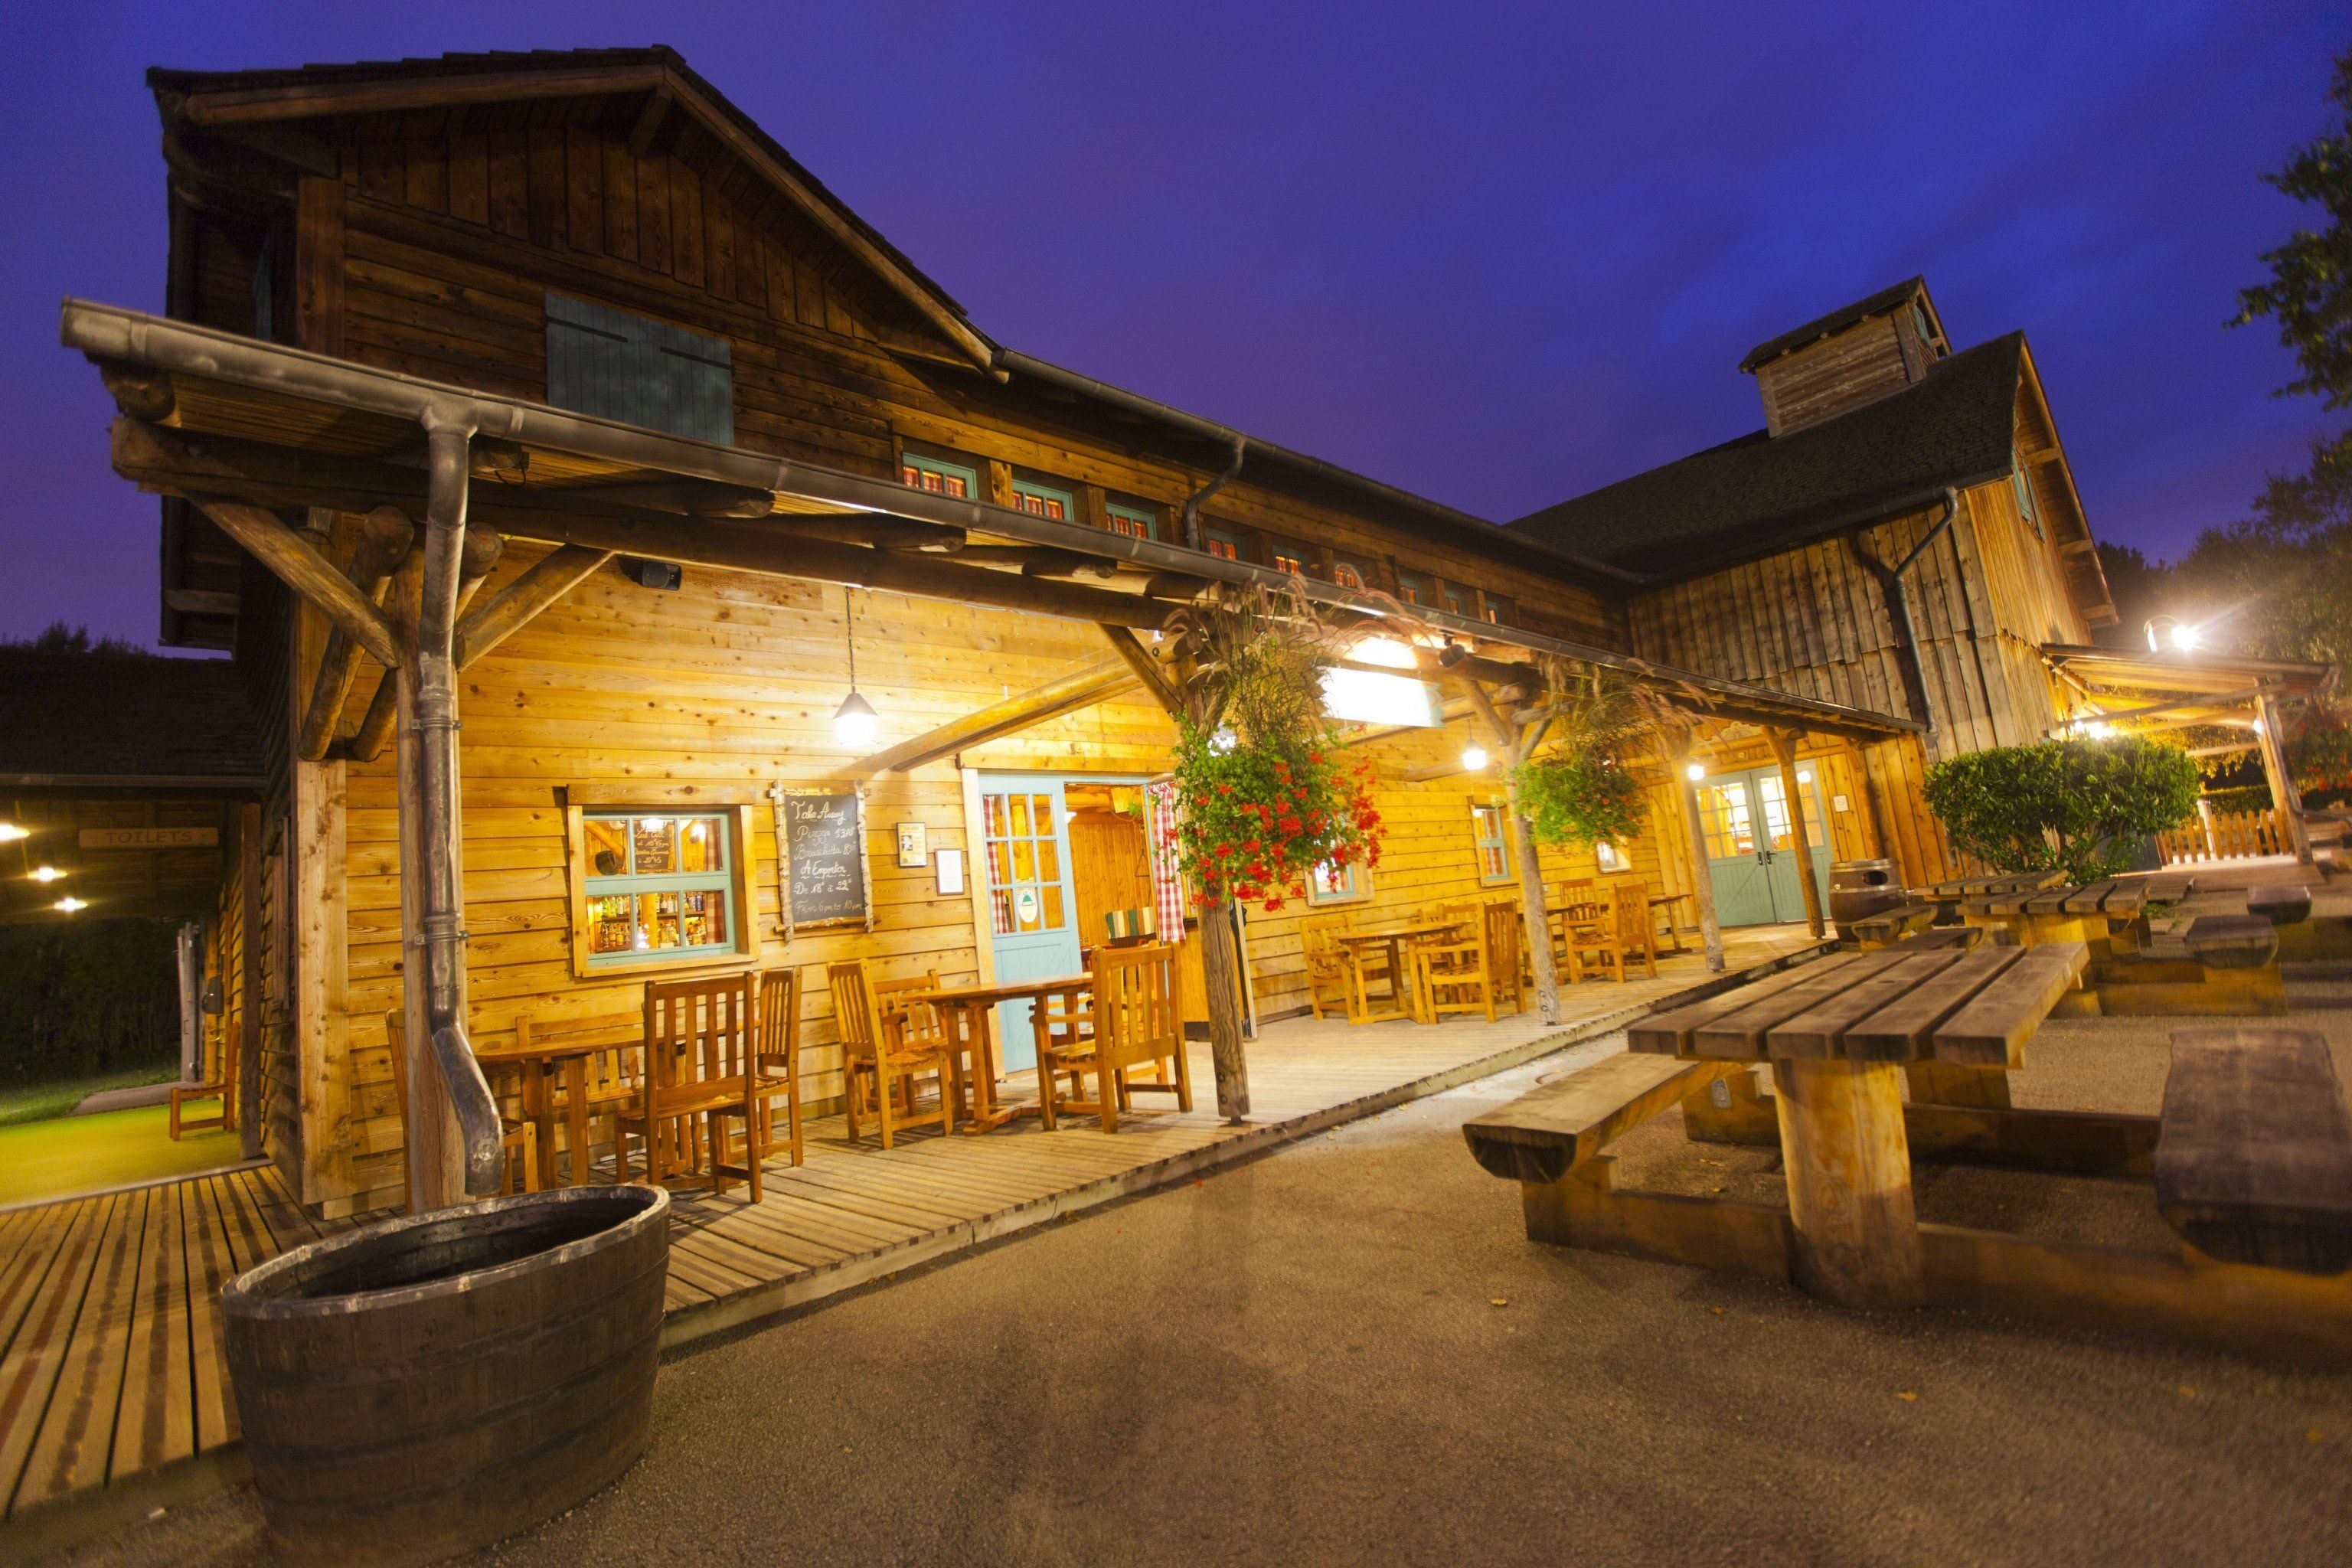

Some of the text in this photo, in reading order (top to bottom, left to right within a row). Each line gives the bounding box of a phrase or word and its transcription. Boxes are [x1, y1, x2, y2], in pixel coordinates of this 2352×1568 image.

[790, 801, 847, 825] Take Away
[105, 831, 191, 843] TOILETS
[793, 825, 831, 846] Pizza
[800, 859, 810, 874] A
[793, 882, 808, 894] De
